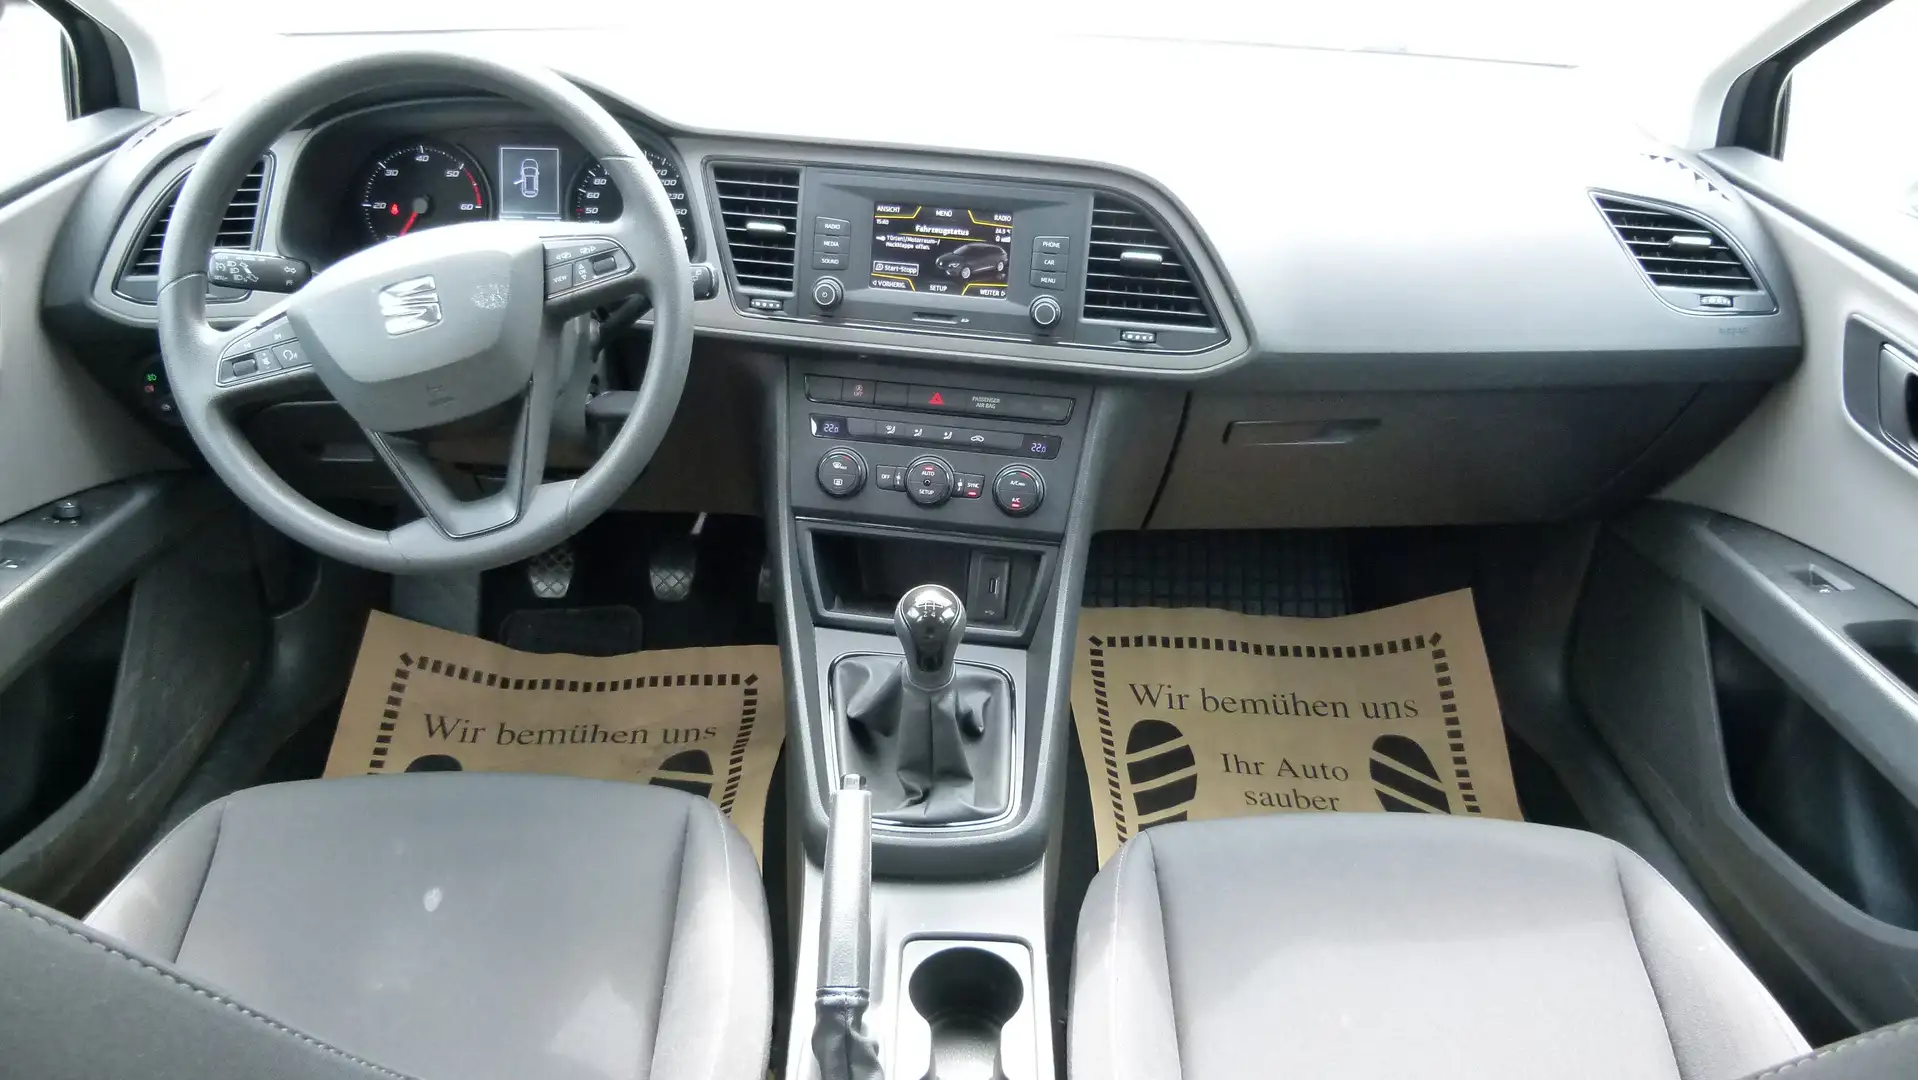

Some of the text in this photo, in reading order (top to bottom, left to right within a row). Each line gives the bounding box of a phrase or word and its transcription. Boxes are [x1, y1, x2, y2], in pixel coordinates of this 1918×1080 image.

[876, 205, 900, 213] ANSICHT
[993, 214, 1012, 222] RADIO
[915, 224, 970, 237] Fahrzeugstatus
[1042, 241, 1061, 249] PHONE
[884, 264, 917, 275] Start-Stopp
[552, 275, 567, 283] VIEW
[929, 284, 948, 292] SETUP
[979, 289, 1000, 297] WEITER
[971, 396, 1001, 404] PASSENGER
[1128, 682, 1420, 720] Wir bemühen uns
[422, 712, 718, 746] Wir bemühen uns
[1219, 752, 1350, 783] Ihr Auto
[1244, 787, 1341, 813] sauber
